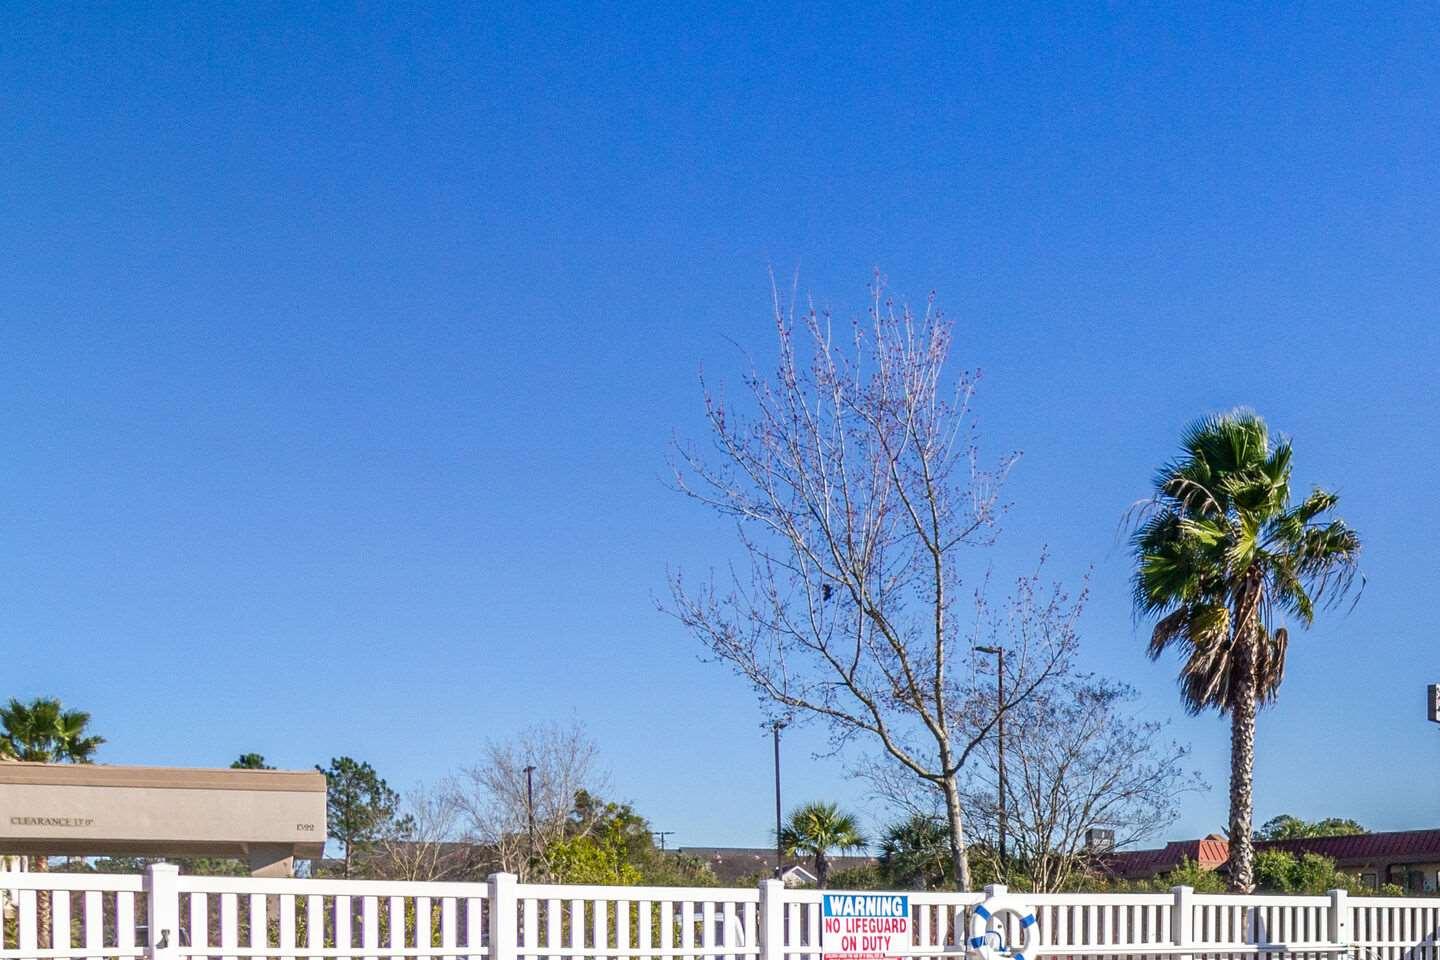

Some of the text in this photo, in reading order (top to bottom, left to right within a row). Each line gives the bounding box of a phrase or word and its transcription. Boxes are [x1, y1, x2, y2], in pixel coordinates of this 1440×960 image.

[10, 816, 69, 826] CLEARANCE
[829, 896, 904, 917] WARNING
[825, 918, 907, 933] NO LIFEGUARD
[841, 936, 891, 951] ON DUTY
